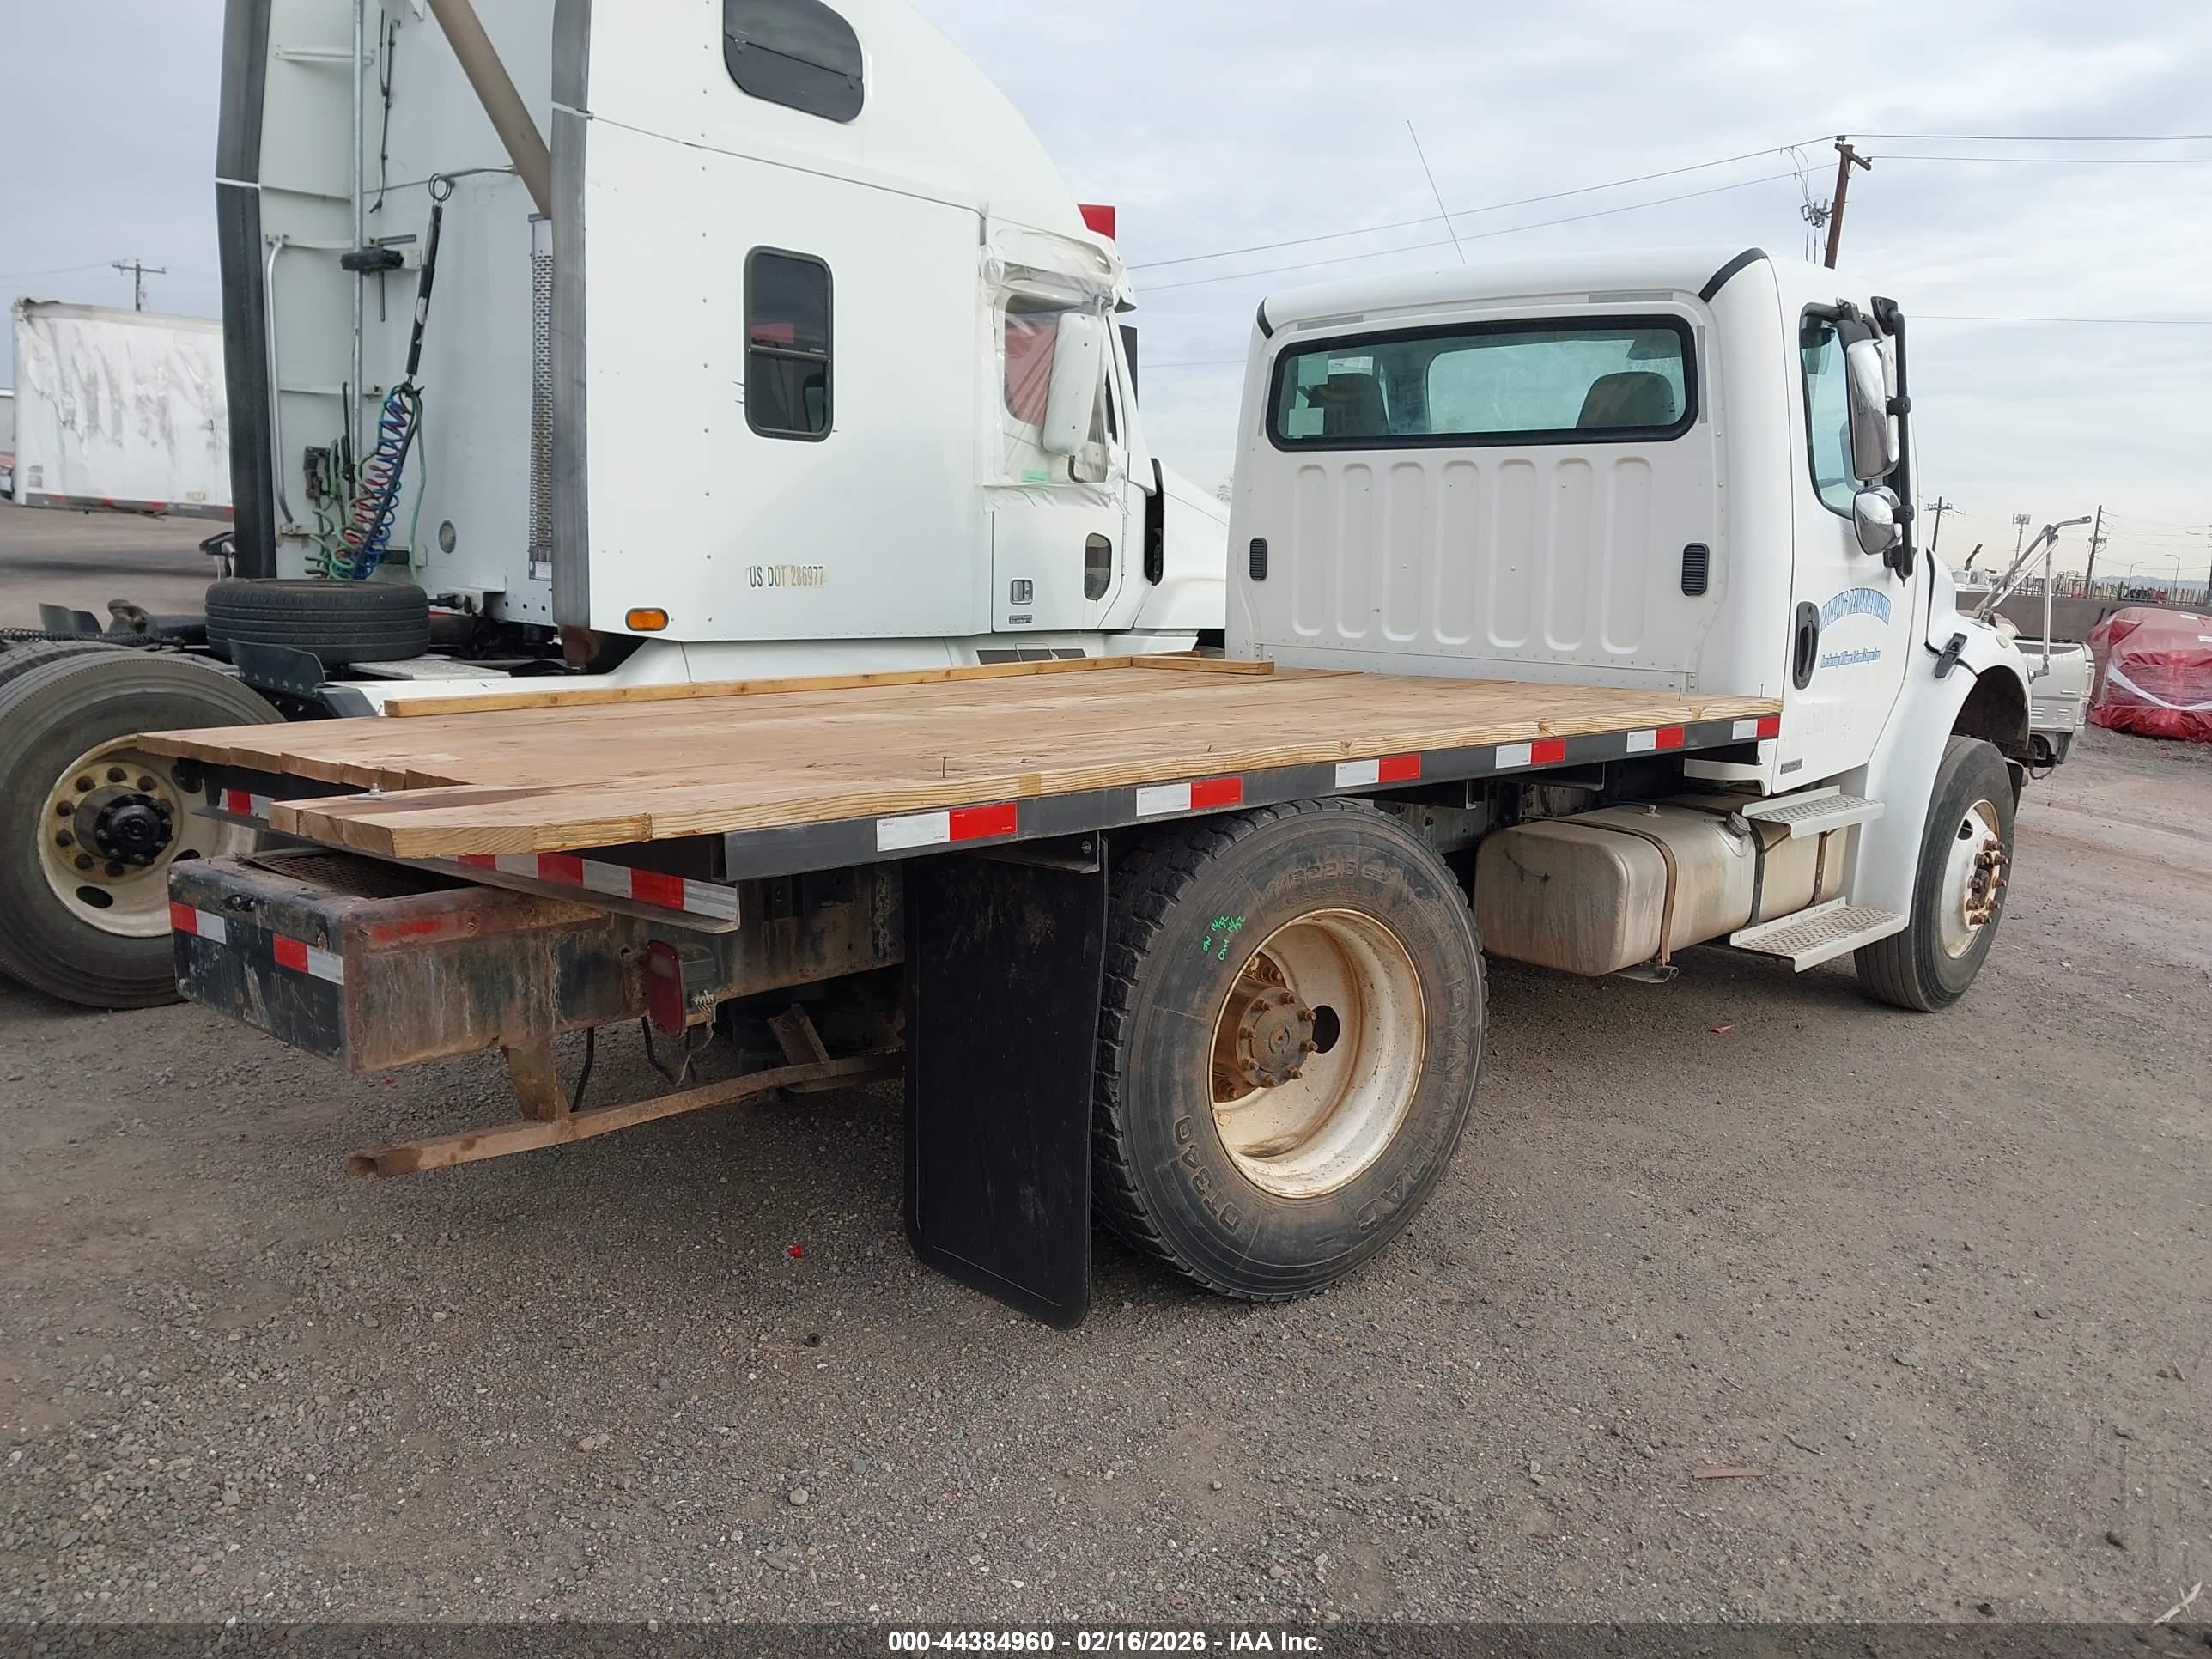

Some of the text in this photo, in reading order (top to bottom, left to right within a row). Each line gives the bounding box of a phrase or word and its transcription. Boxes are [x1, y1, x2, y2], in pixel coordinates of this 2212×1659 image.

[749, 565, 824, 588] US DOT 286977
[1173, 1114, 1243, 1234] DT340
